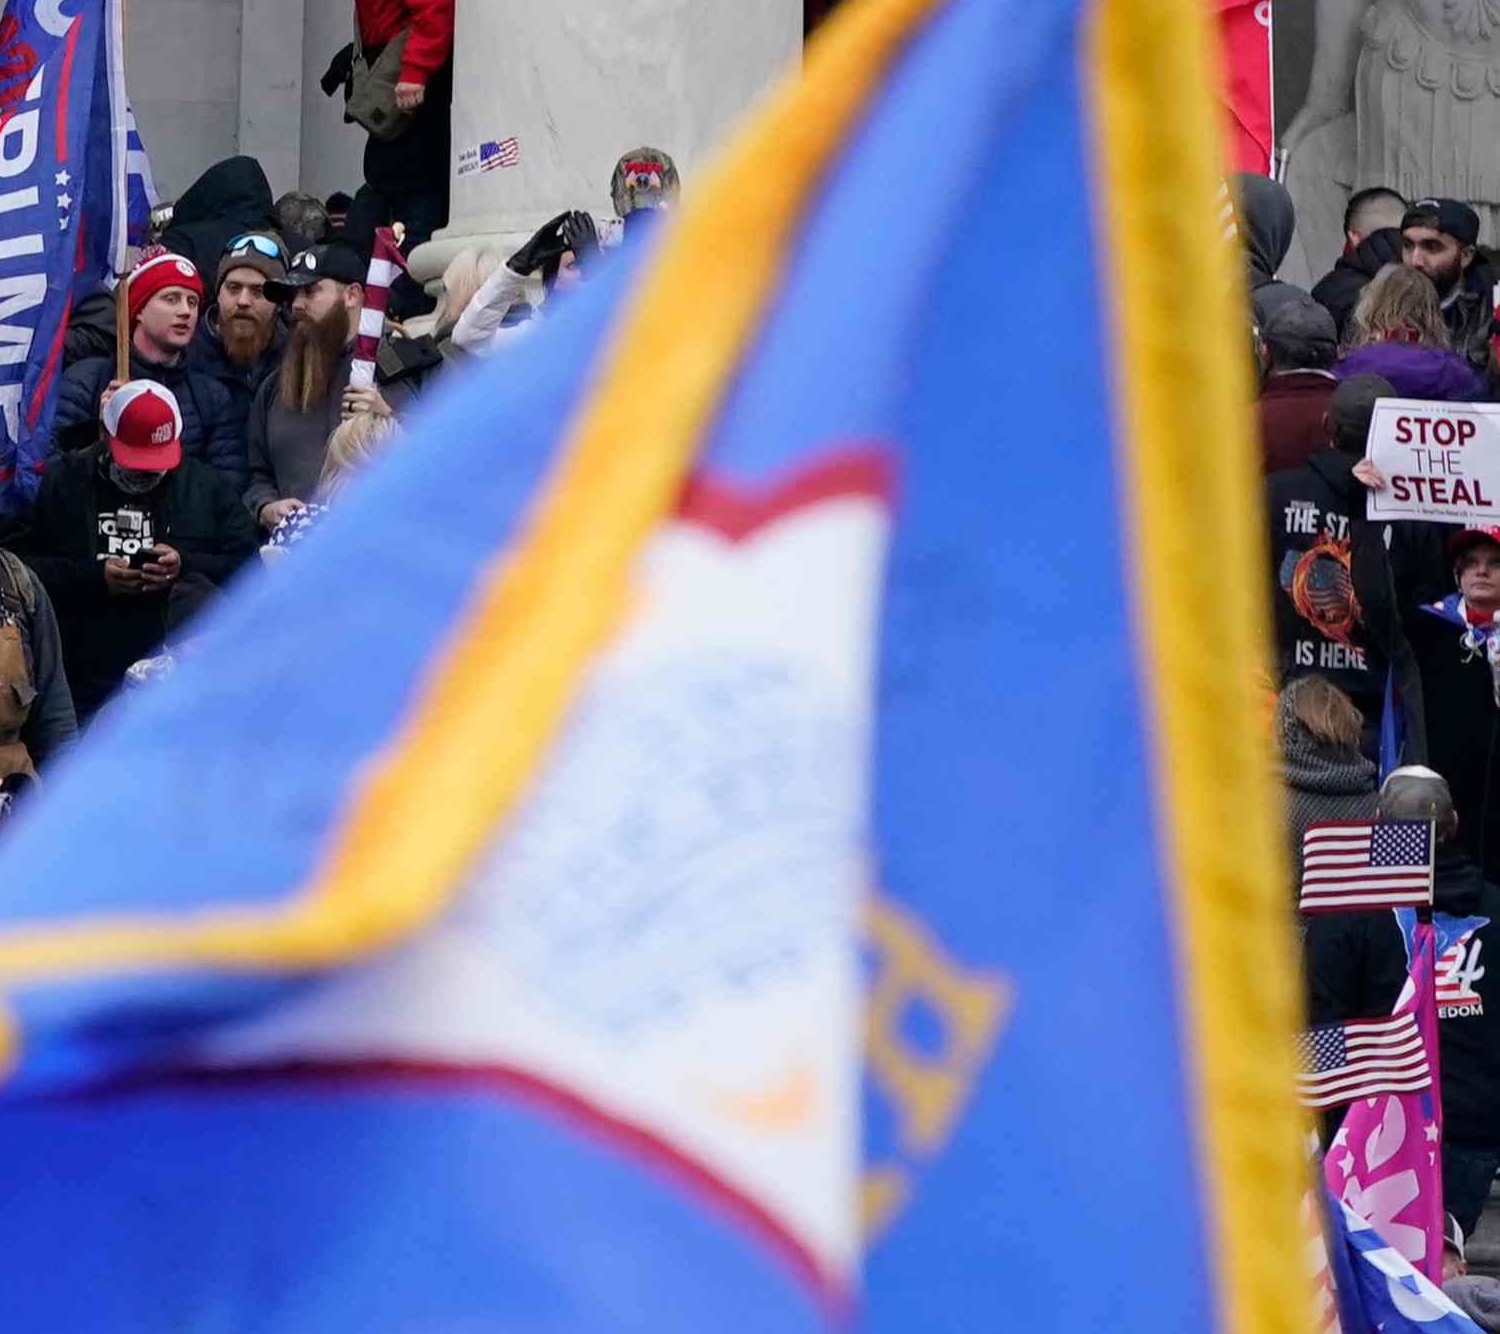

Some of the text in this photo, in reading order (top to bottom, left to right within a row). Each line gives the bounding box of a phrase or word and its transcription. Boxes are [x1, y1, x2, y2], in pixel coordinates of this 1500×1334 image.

[1395, 416, 1476, 449] STOP
[1412, 445, 1463, 478] THE
[1391, 476, 1493, 510] STEAL
[1284, 508, 1319, 535] THE
[1296, 641, 1313, 666] IS
